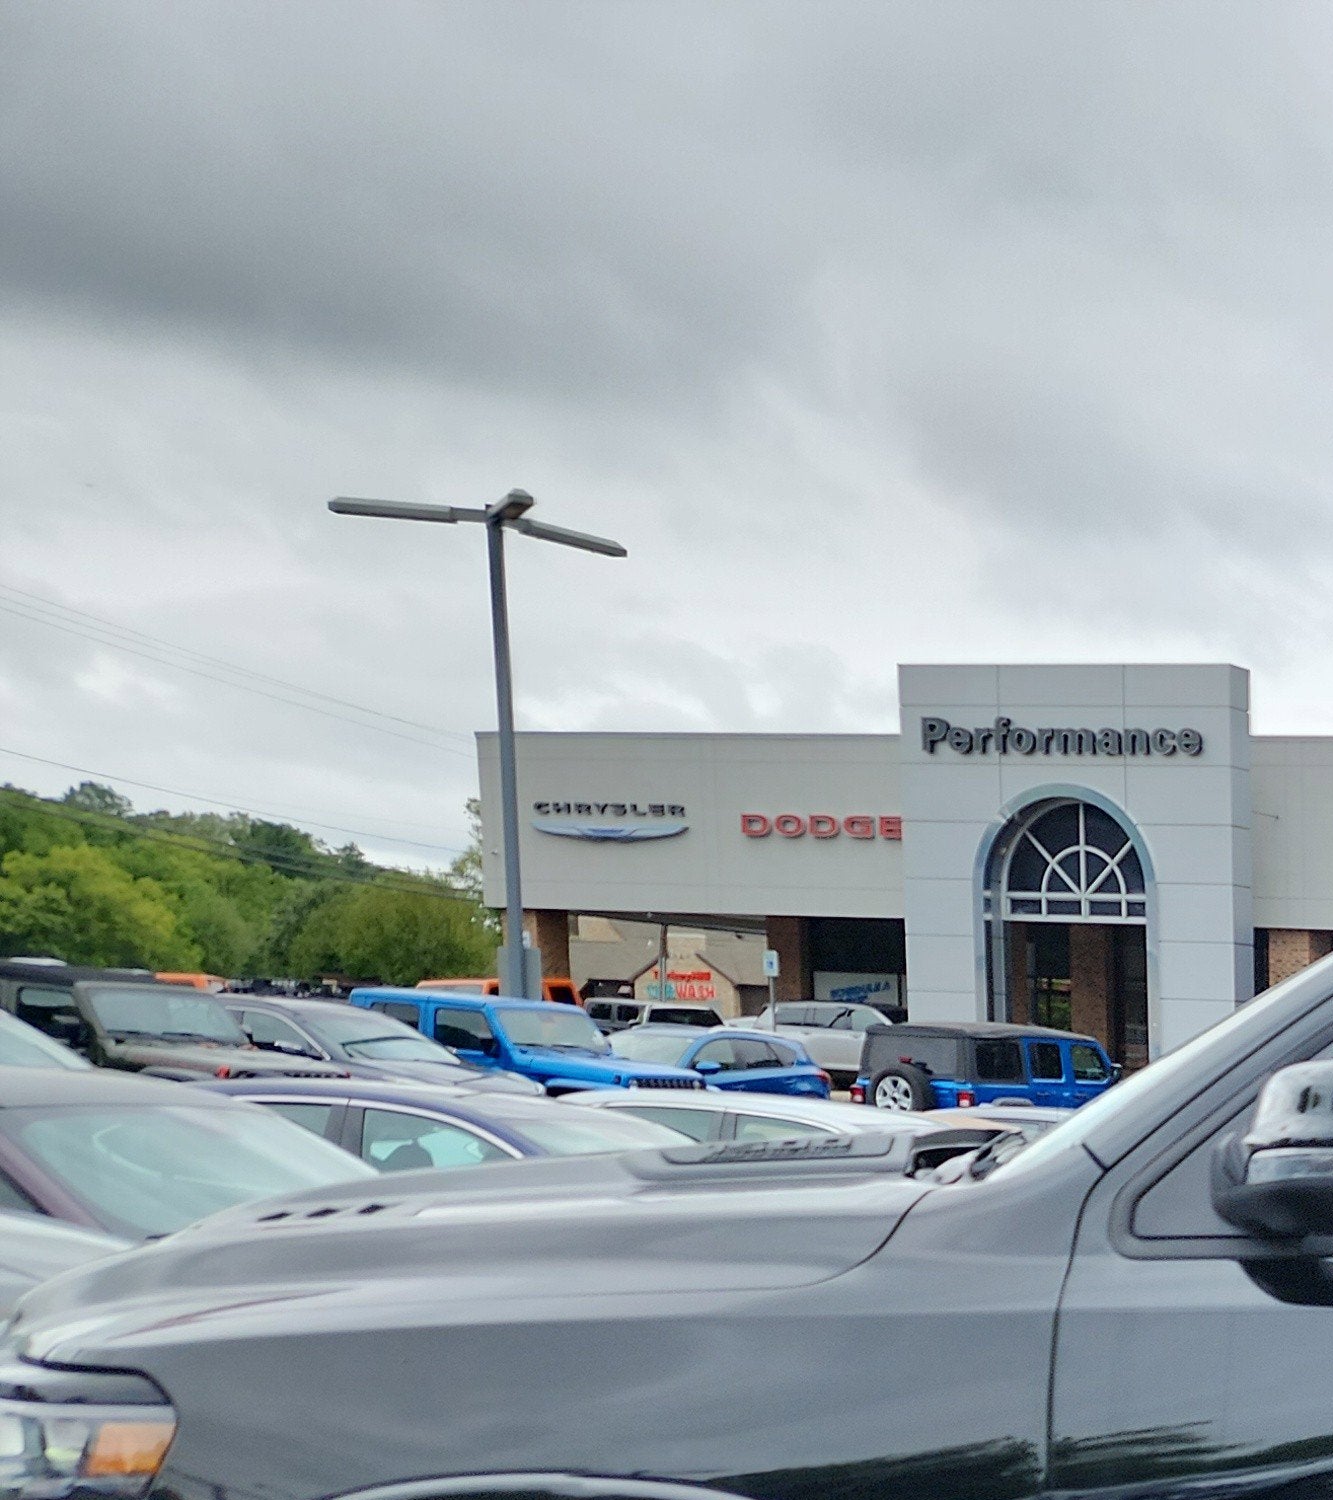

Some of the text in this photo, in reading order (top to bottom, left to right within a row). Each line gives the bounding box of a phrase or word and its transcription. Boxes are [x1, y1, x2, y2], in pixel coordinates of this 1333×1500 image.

[921, 716, 1204, 756] Performance
[533, 801, 686, 818] CHRYSLER
[740, 814, 902, 840] DODGE
[676, 983, 716, 1000] WASH
